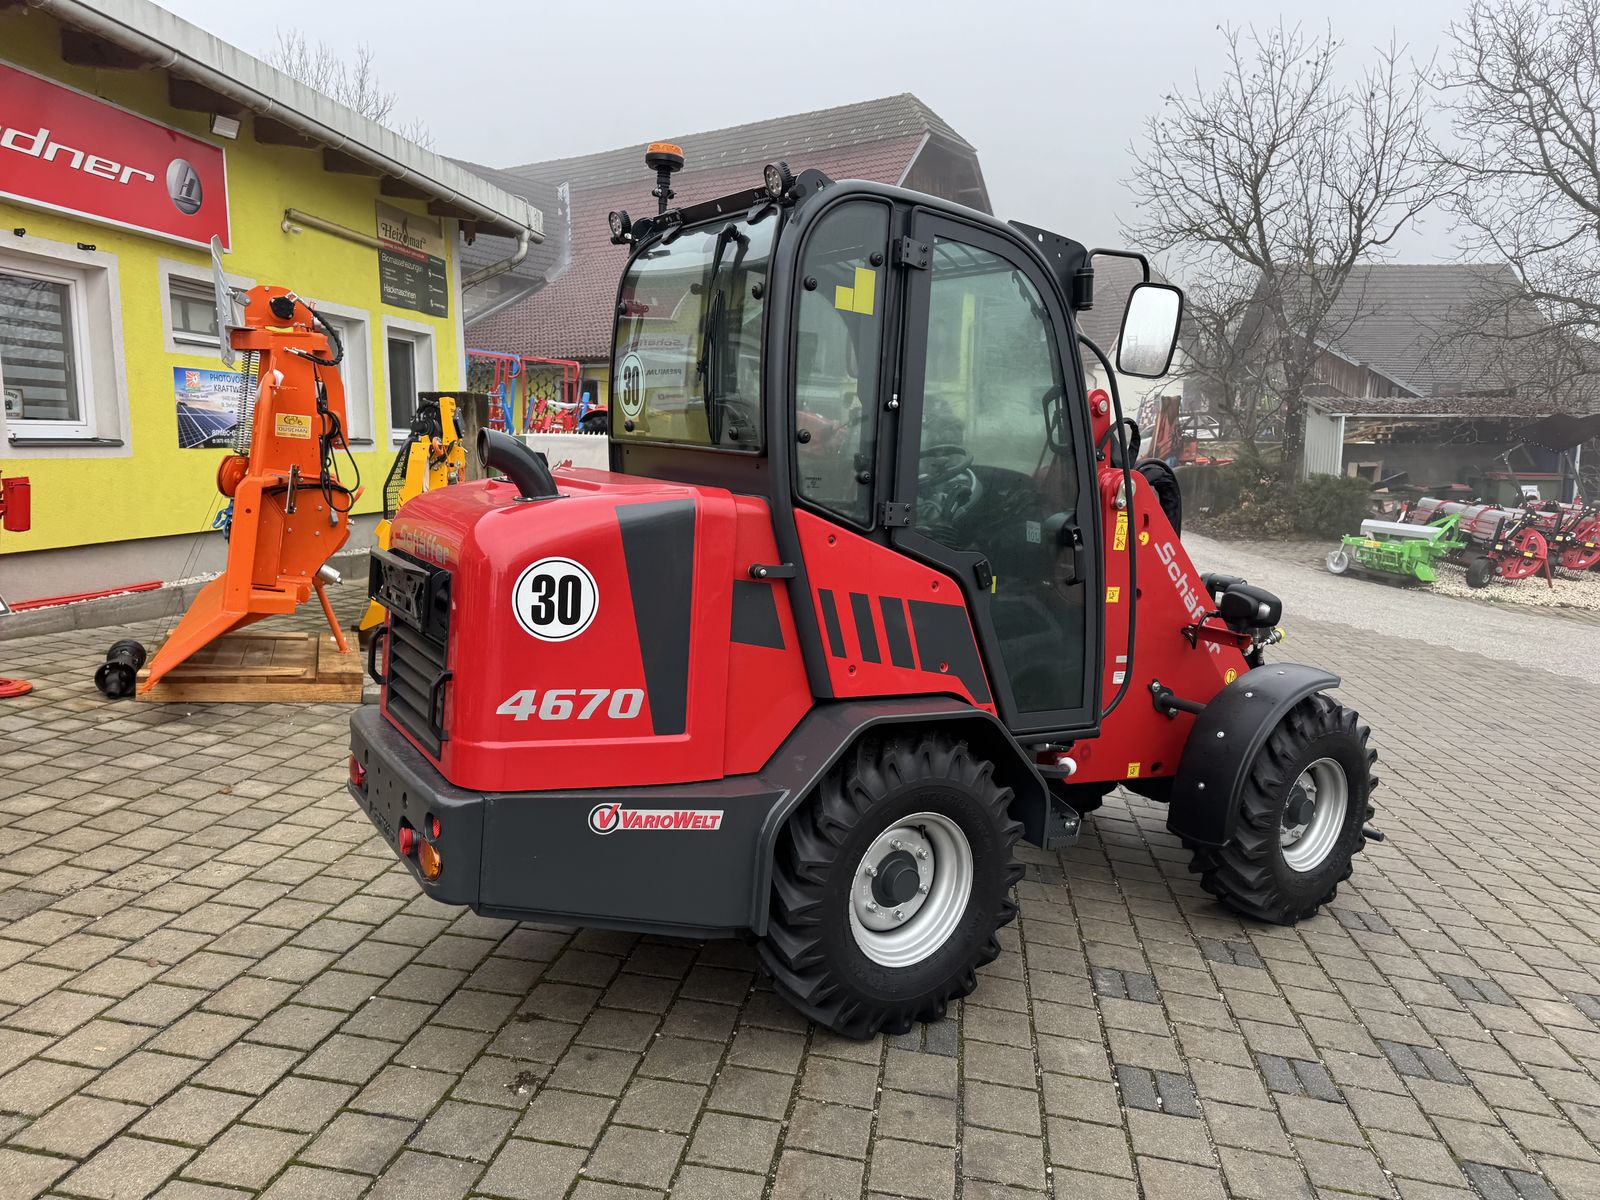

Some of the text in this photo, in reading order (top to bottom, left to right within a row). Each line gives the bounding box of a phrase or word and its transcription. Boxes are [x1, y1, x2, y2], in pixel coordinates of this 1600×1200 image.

[0, 126, 155, 185] dner
[209, 373, 241, 384] PHOTOVO
[213, 383, 242, 393] KRAFTW
[623, 366, 640, 406] 30
[397, 523, 450, 565] Schäffer
[530, 573, 583, 626] 30
[495, 688, 646, 721] 4670
